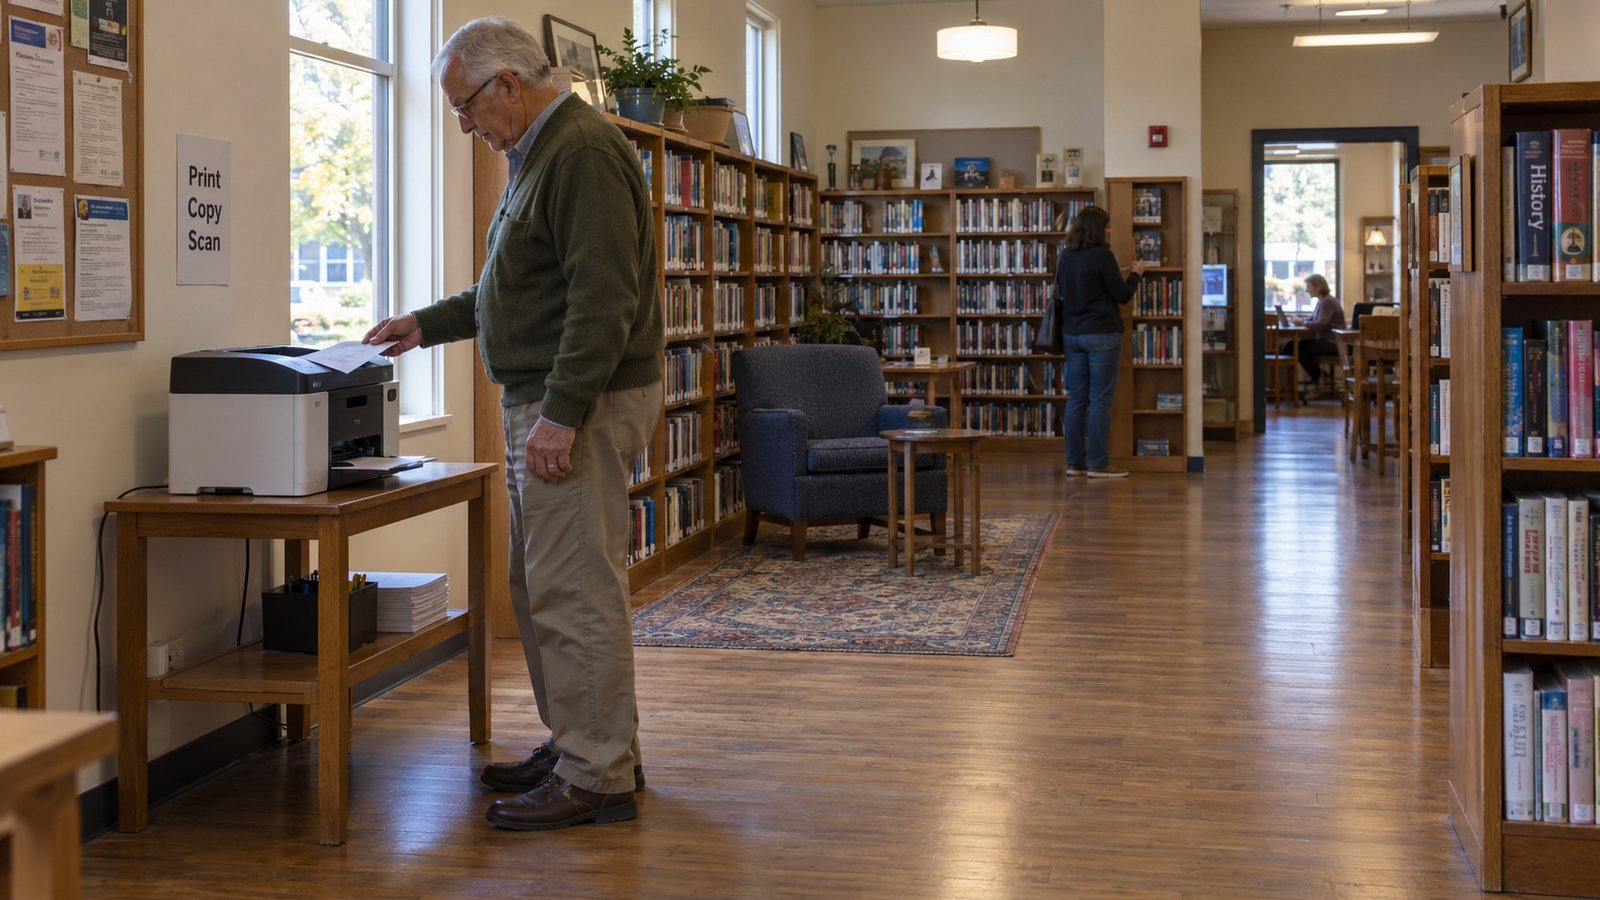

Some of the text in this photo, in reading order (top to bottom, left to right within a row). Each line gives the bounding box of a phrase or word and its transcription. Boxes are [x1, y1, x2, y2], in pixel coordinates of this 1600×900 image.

[188, 165, 221, 189] Print
[1528, 164, 1547, 231] History
[188, 197, 222, 225] Copy
[188, 229, 221, 251] Scan
